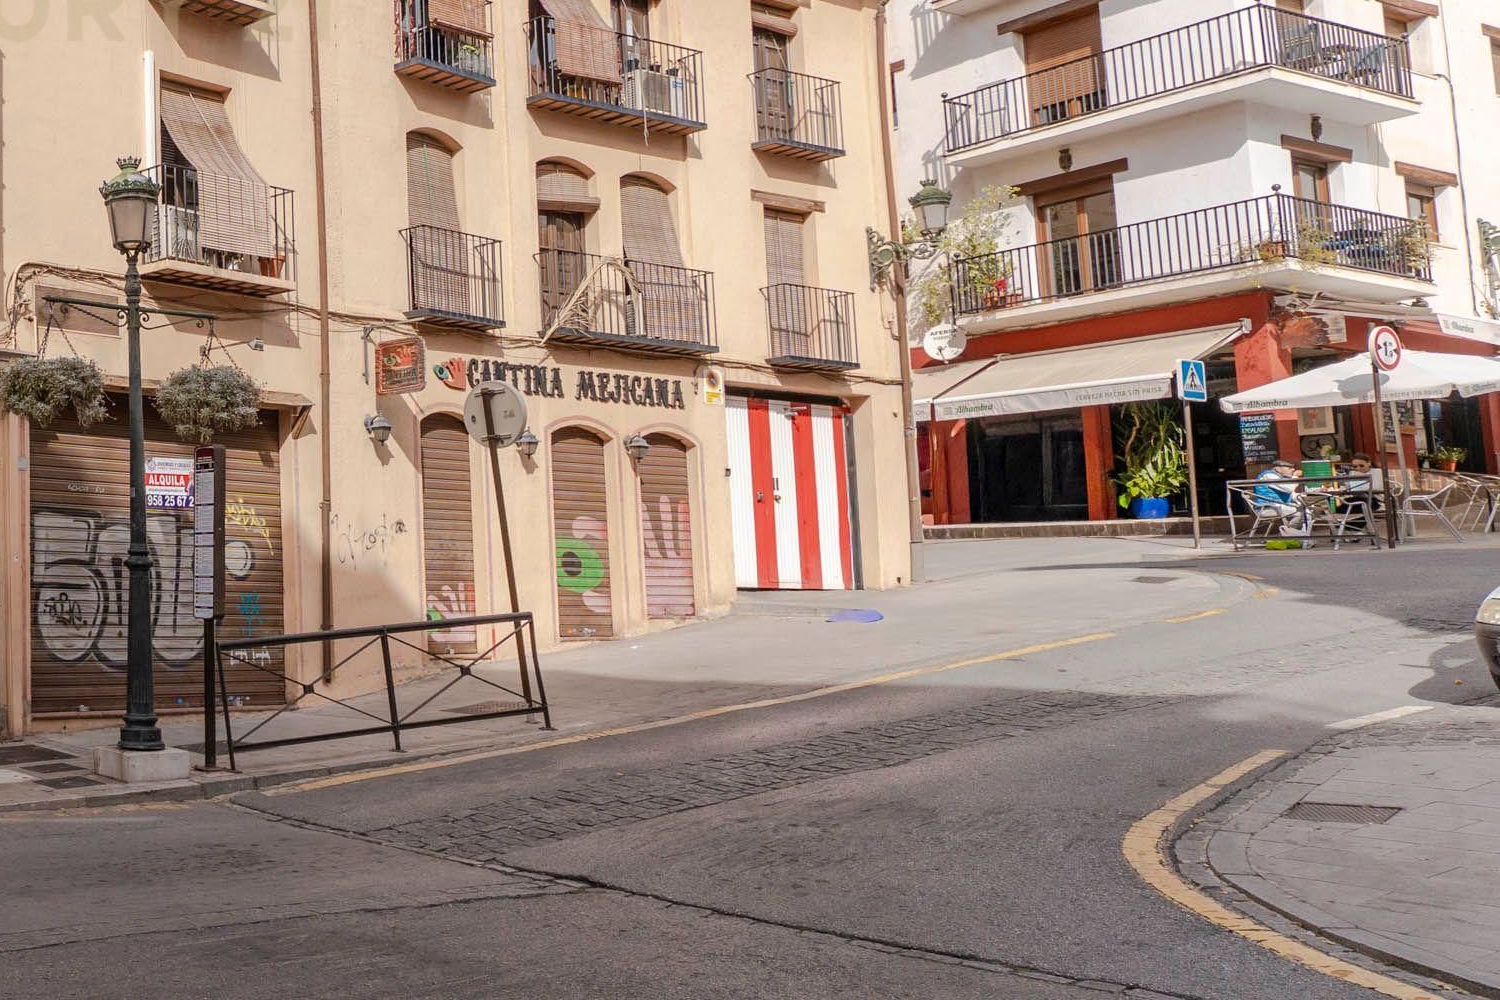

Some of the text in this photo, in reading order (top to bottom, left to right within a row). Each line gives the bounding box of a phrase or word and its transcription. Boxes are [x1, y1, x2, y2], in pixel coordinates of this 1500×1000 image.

[467, 358, 685, 409] CANTINA MEJICANA
[956, 403, 994, 414] Alhambra
[1246, 399, 1288, 409] Alhambra
[148, 474, 185, 486] ALQUILA
[147, 494, 163, 506] 958
[164, 496, 176, 507] 25
[177, 496, 187, 507] 67
